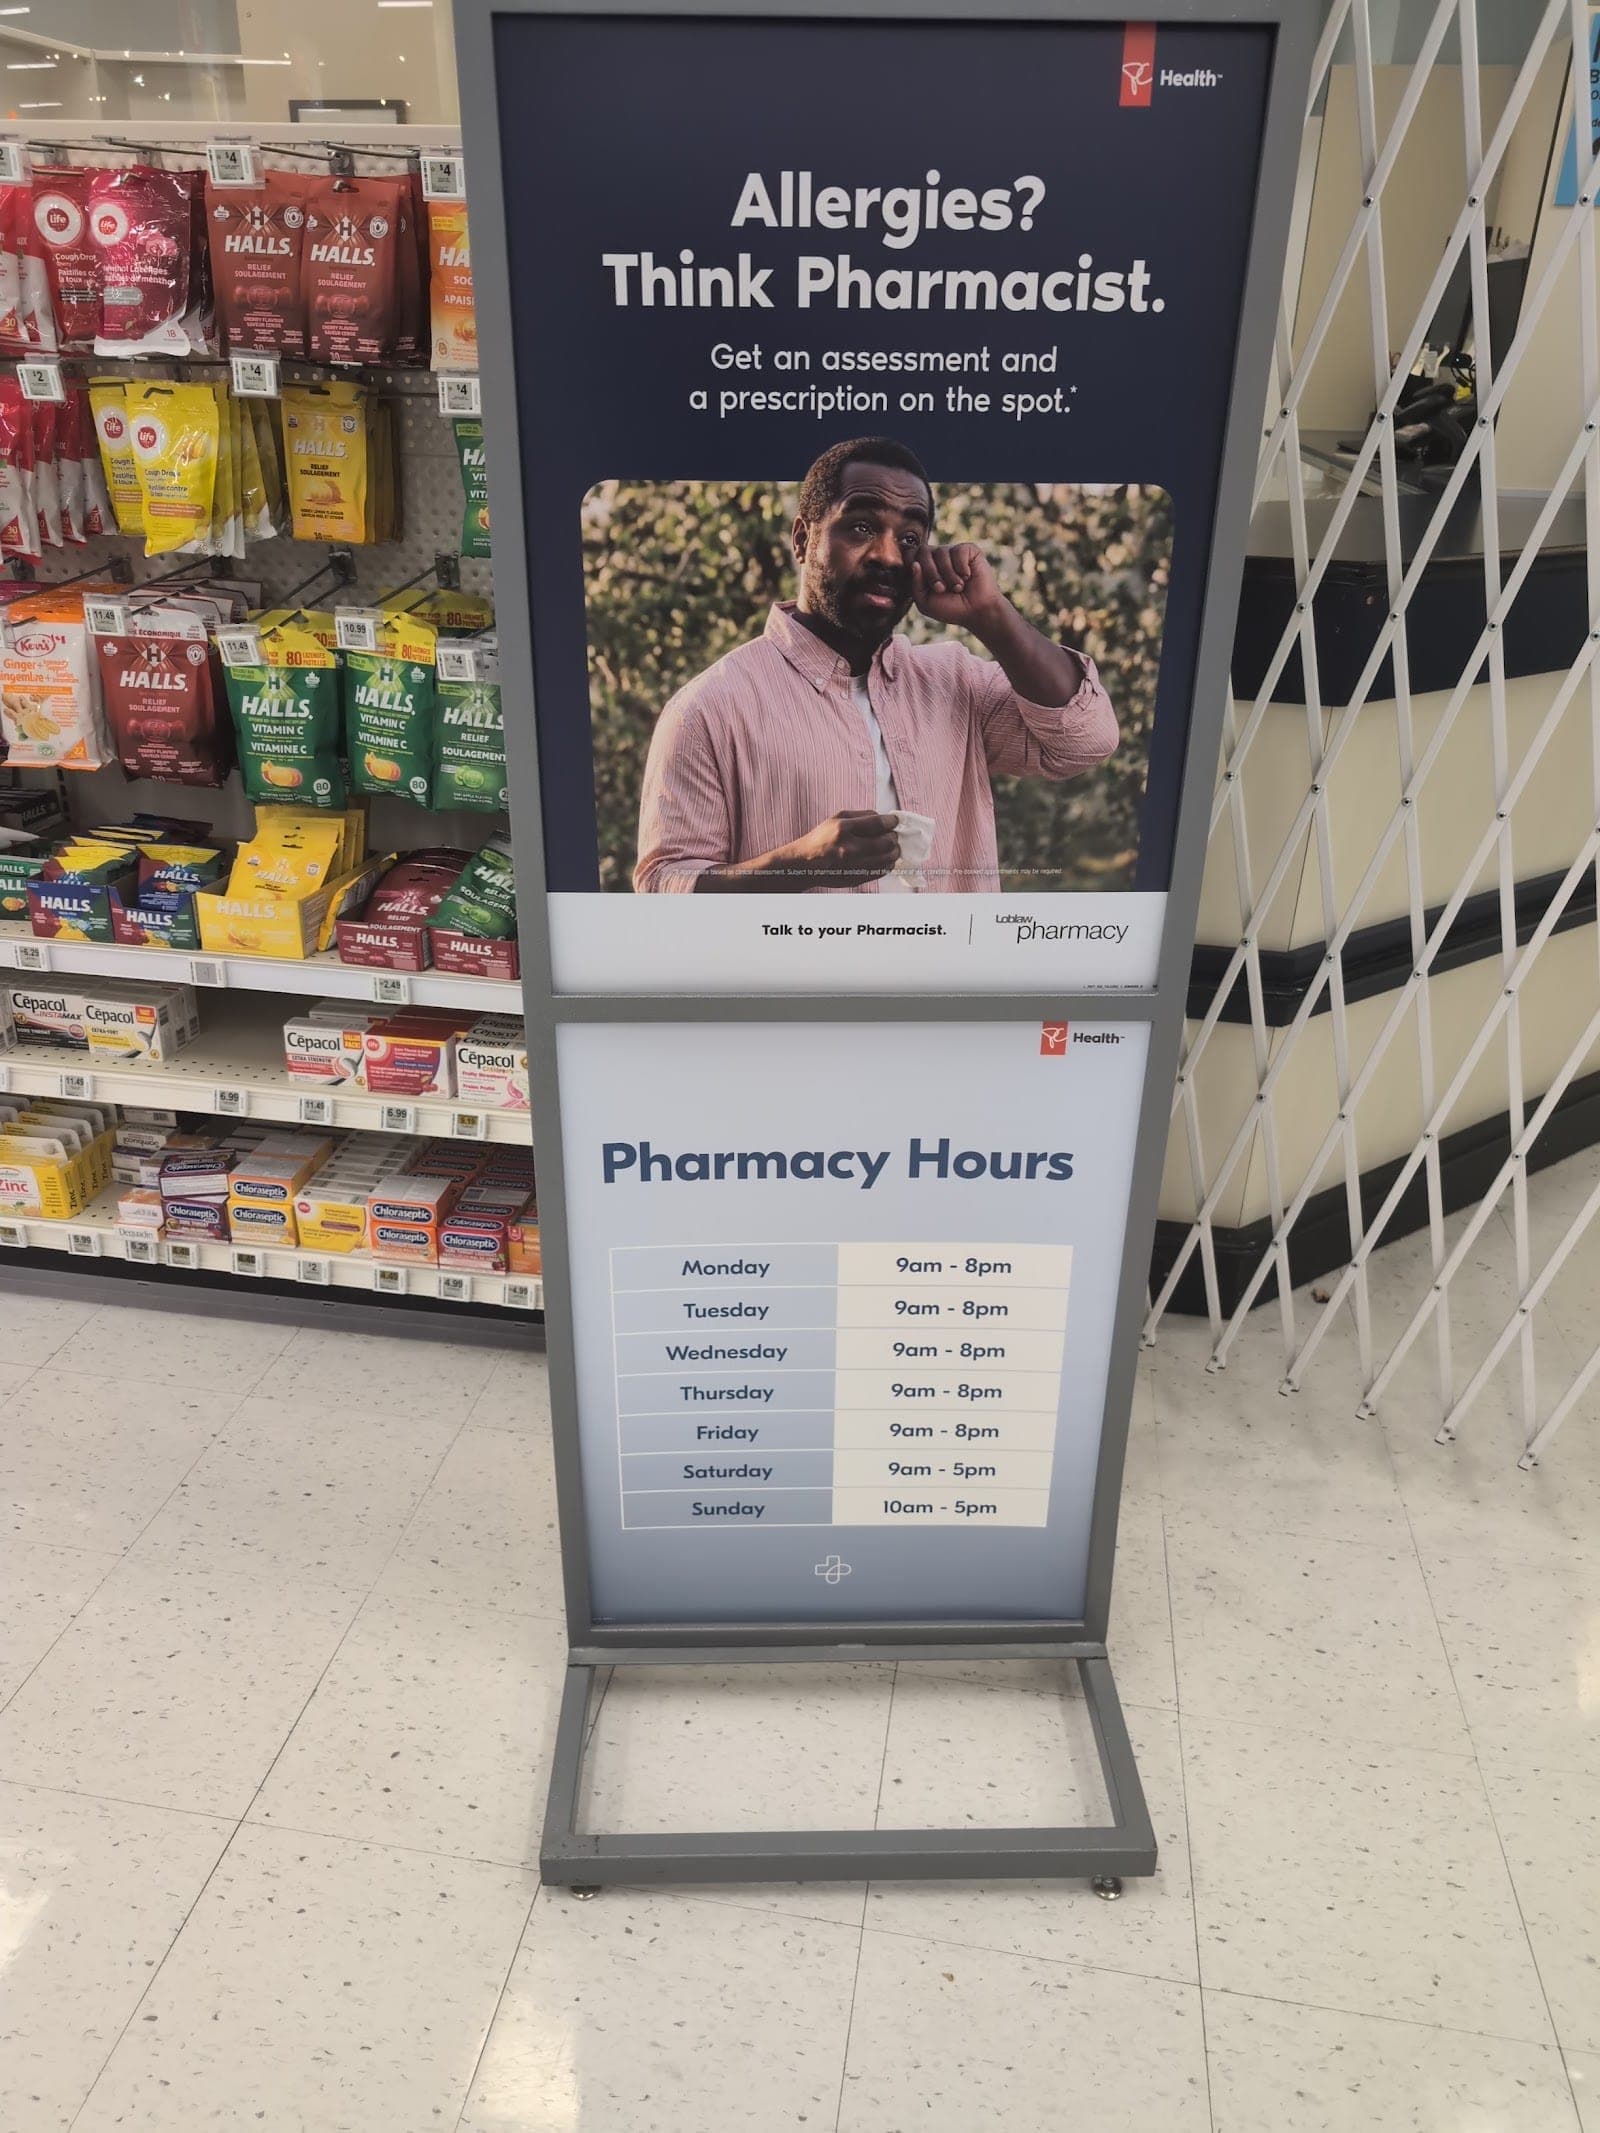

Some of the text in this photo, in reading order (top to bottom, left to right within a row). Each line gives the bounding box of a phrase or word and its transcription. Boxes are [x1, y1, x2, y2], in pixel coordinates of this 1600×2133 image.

[730, 168, 1046, 250] Allergies?
[602, 248, 1165, 313] Think Pharmacist.
[711, 343, 1058, 373] Get an assessment and
[689, 390, 708, 410] a
[720, 384, 888, 420] prescription
[899, 392, 935, 412] on
[946, 385, 991, 412] the
[94, 609, 116, 621] 11.49
[345, 624, 367, 634] 10.99
[286, 651, 302, 666] 80
[401, 645, 412, 659] 80
[119, 670, 189, 692] HALLS.
[241, 695, 314, 720] HALLS.
[355, 684, 416, 716] HALLS.
[252, 723, 304, 735] VITAMIN C
[359, 712, 406, 730] VITAMIN C
[358, 731, 407, 749] VITAMINE C
[461, 732, 490, 743] RELIEF
[251, 741, 307, 754] VITAMINE C
[316, 781, 329, 791] 80
[411, 781, 425, 790] 80
[154, 869, 201, 883] HALLS.
[41, 895, 94, 914] HALLS.
[377, 902, 430, 916] HALLS.
[126, 910, 176, 927] HALLS.
[762, 924, 947, 939] Talk to your Pharmacist.
[1017, 921, 1129, 944] pharmacy
[356, 933, 399, 949] HALLS.
[450, 940, 494, 957] HALLS.
[219, 1092, 239, 1102] 6.99
[387, 1108, 407, 1118] 6.99
[602, 1137, 1075, 1190] Pharmacy Hours
[235, 1183, 286, 1198] Chloraseptic
[168, 1204, 216, 1220] Chloraseptic
[234, 1209, 284, 1224] Chloraseptic
[373, 1205, 430, 1221] Chloraseptic
[377, 1229, 427, 1244] Chloraseptic
[443, 1233, 496, 1250] Chloraseptic
[681, 1259, 771, 1279] Monday
[896, 1257, 942, 1273] 9am
[965, 1257, 1012, 1277] 8pm
[683, 1302, 770, 1321] Tuesday
[894, 1300, 940, 1315] 9am
[962, 1300, 1009, 1319] 8pm
[665, 1344, 788, 1362] Wednesday
[892, 1342, 938, 1357] 9am
[960, 1342, 1006, 1361] 8pm
[680, 1385, 774, 1402] Thursday
[891, 1383, 936, 1398] 9am
[957, 1383, 1003, 1401] 8pm
[696, 1425, 759, 1442] Friday
[889, 1423, 934, 1437] 9am
[955, 1423, 1000, 1441] 8pm
[683, 1464, 773, 1481] Saturday
[888, 1462, 932, 1476] 9am
[953, 1462, 997, 1479] 5pm
[691, 1502, 766, 1518] Sunday
[884, 1500, 934, 1514] 10am
[954, 1500, 997, 1517] 5pm
